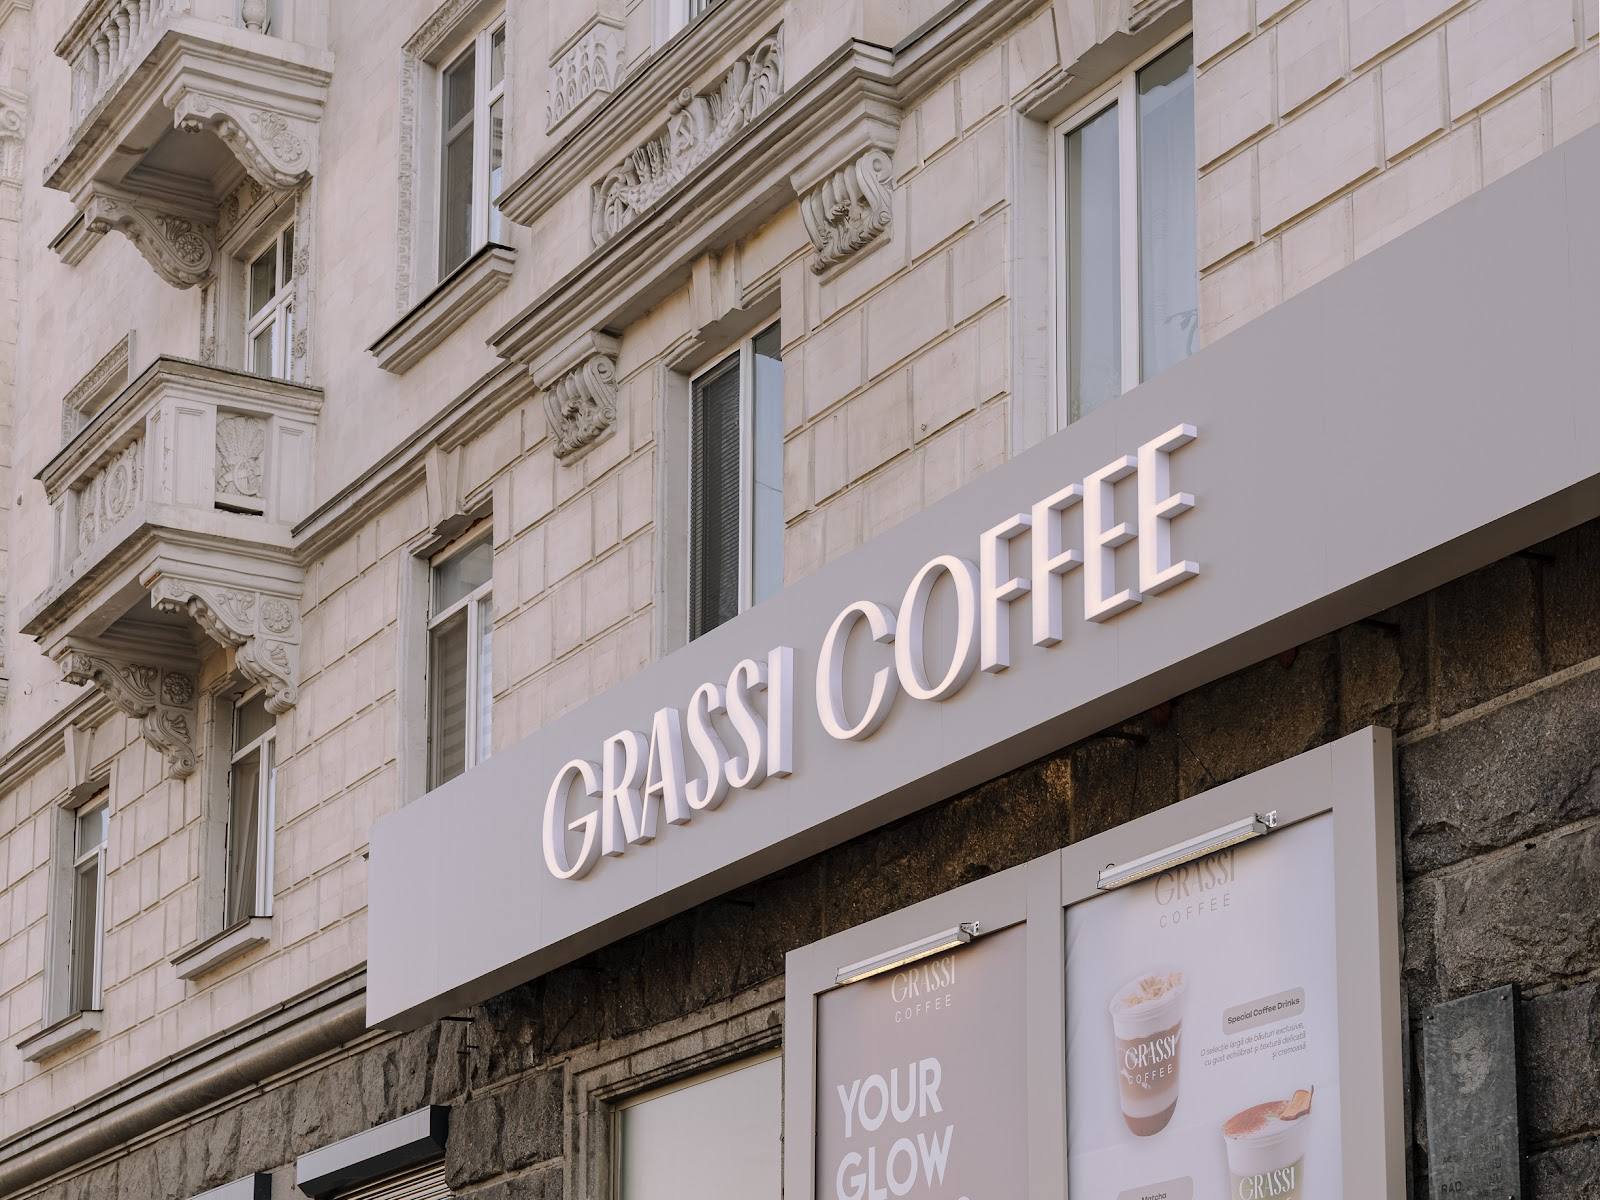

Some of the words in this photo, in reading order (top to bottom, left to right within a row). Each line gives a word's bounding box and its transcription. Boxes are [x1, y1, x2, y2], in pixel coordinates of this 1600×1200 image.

[541, 647, 793, 881] GRASSI
[815, 423, 1199, 741] COFFEE
[1155, 849, 1234, 905] GRASSI
[1160, 893, 1230, 928] COFFEE
[892, 956, 955, 1002] GRASSI
[896, 994, 951, 1022] COFFEE
[1228, 1010, 1252, 1024] Special
[1254, 1005, 1276, 1016] Coffee
[1278, 998, 1300, 1009] Drinks
[1125, 1035, 1175, 1069] GRASSI
[1128, 1064, 1172, 1084] COFFEE
[837, 1057, 943, 1138] YOUR
[1240, 1167, 1294, 1200] GRASSI
